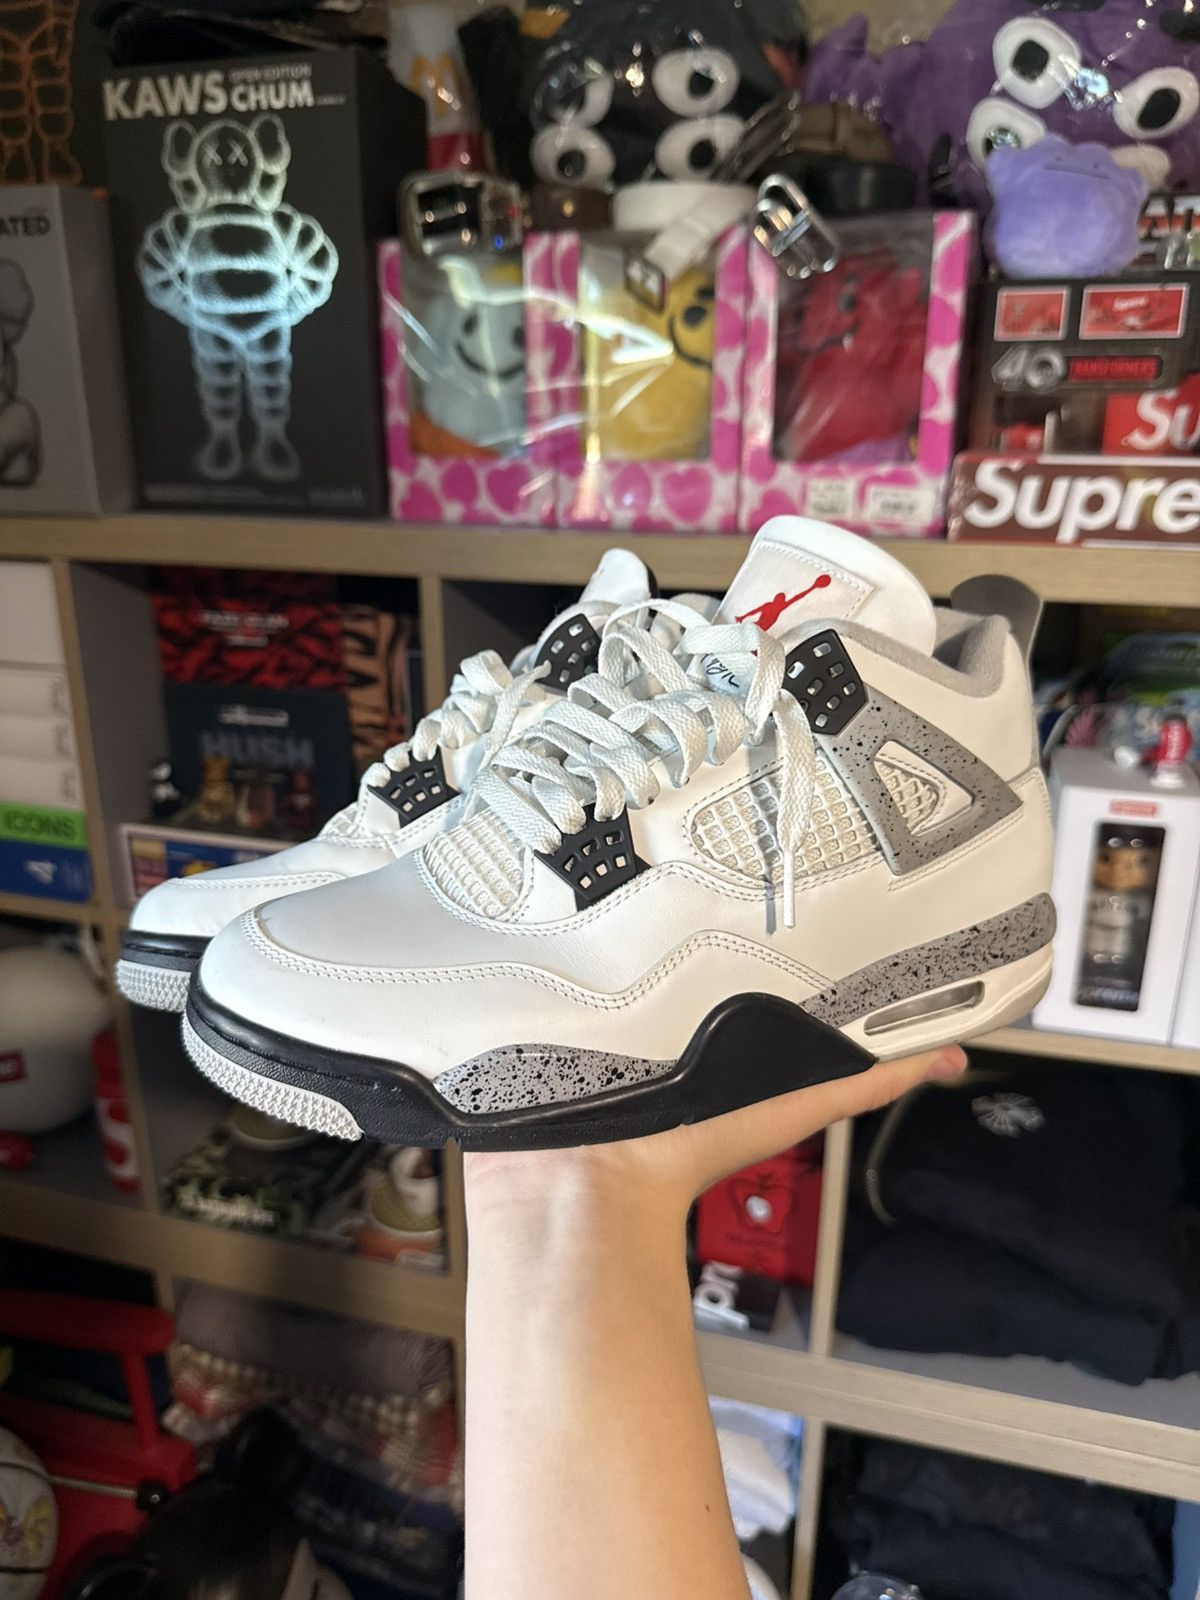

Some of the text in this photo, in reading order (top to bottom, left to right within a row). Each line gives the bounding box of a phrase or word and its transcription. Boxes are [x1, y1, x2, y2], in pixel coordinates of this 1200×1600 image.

[102, 70, 228, 121] KAWS
[230, 79, 315, 113] CHUM
[963, 457, 1200, 545] Supre
